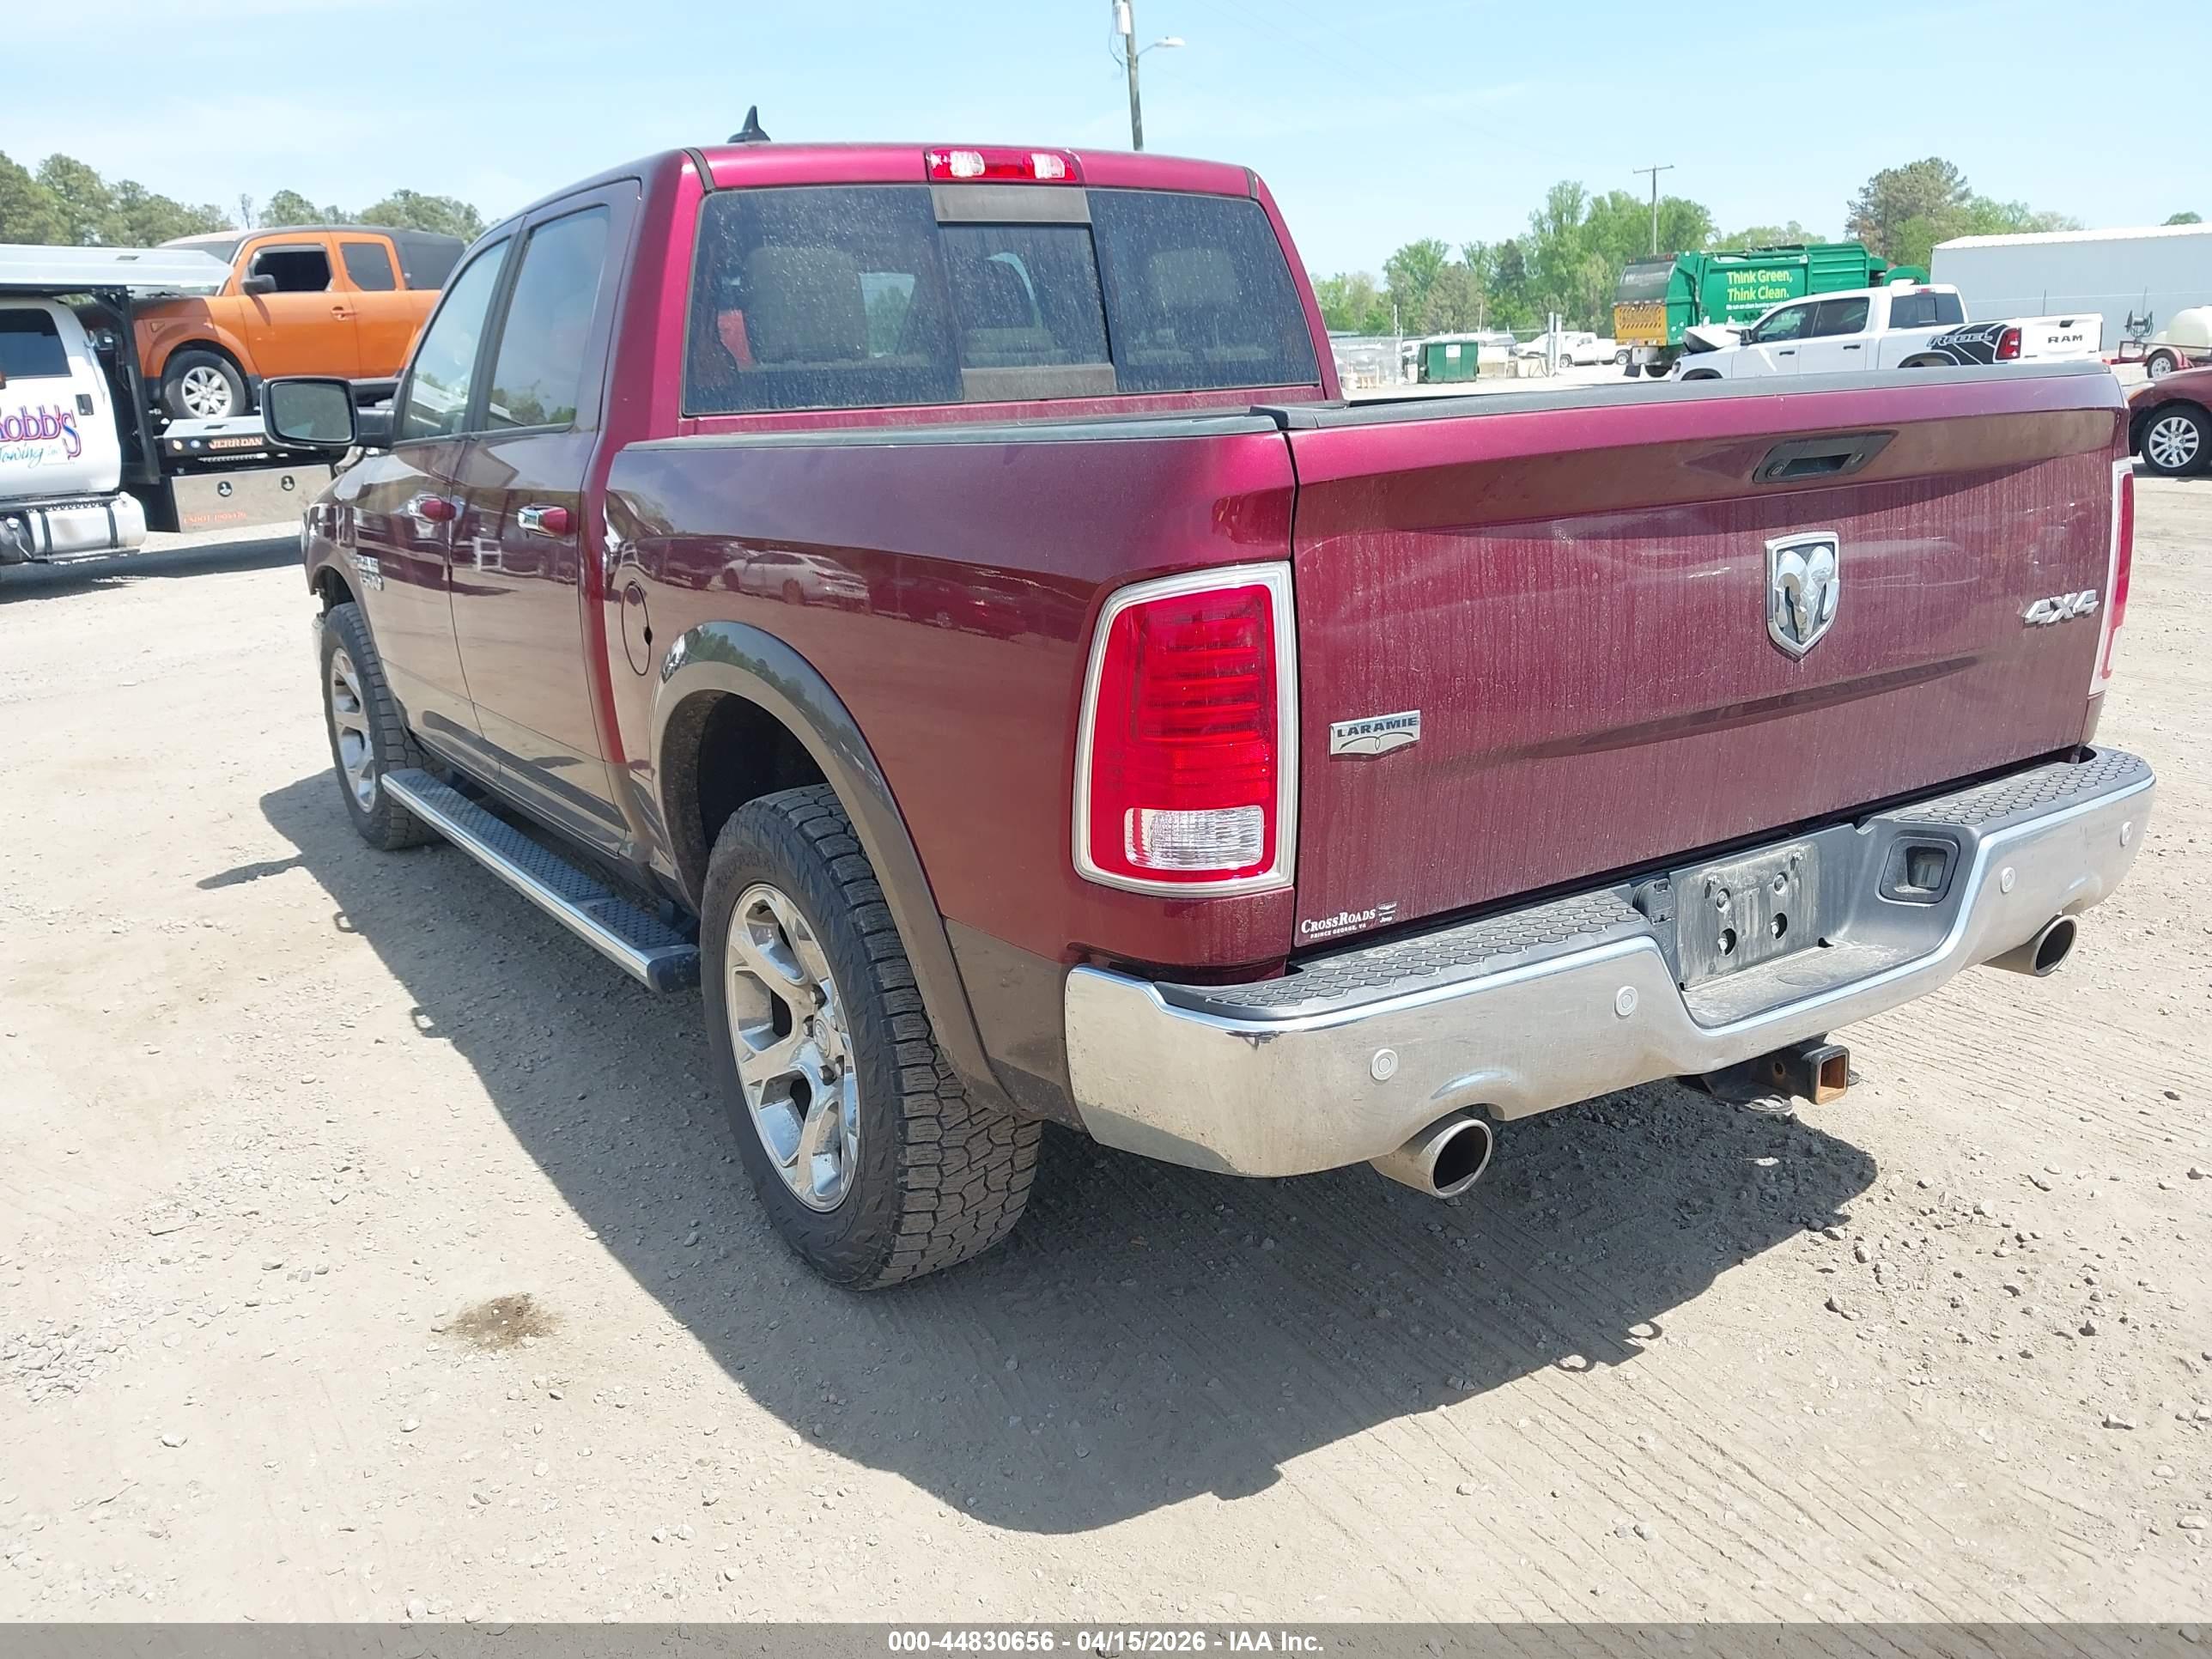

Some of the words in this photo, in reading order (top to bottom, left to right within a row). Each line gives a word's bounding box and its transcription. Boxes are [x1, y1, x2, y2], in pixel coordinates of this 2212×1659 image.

[1726, 270, 1756, 284] Think
[1758, 270, 1793, 283] Green,
[1727, 287, 1756, 301] Think
[1758, 285, 1790, 300] Clean.
[1926, 331, 1993, 347] REBEL
[2048, 334, 2083, 343] RAM
[0, 404, 82, 460] obb's
[1337, 717, 1418, 738] LARAMIE
[1310, 930, 1332, 939] PRINCE
